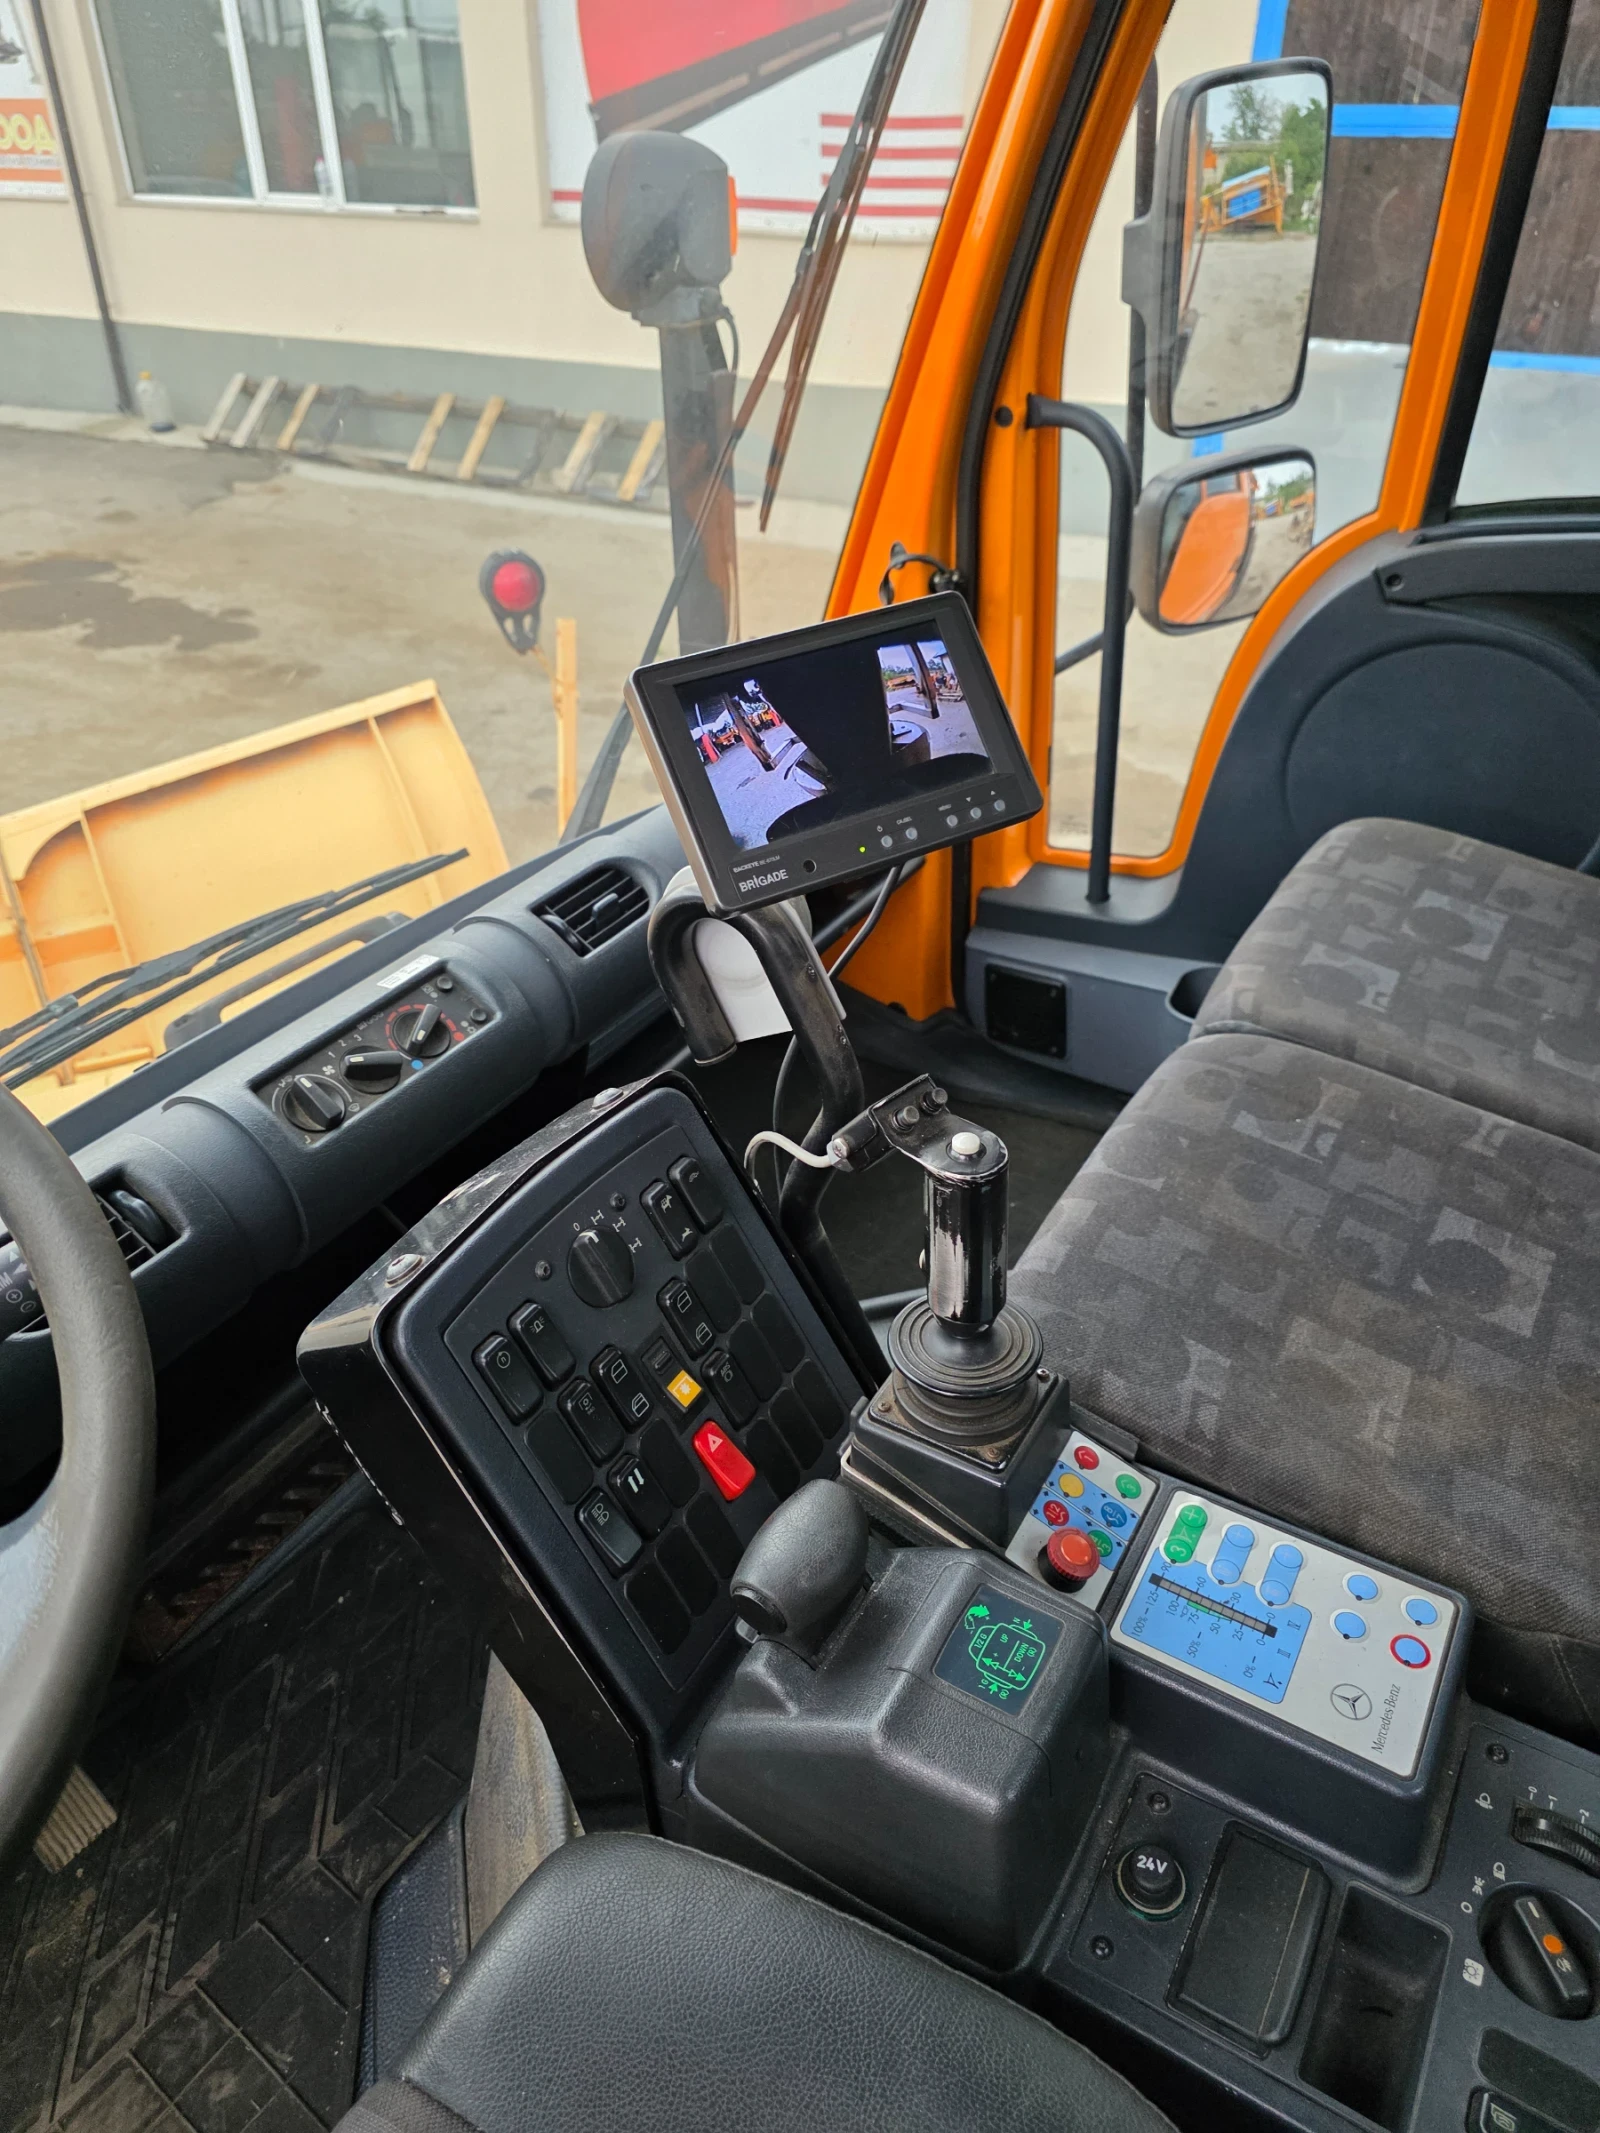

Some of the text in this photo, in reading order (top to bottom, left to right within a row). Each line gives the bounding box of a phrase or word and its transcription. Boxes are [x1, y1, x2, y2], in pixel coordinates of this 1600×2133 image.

[738, 869, 789, 893] BRIGADE
[1197, 1576, 1207, 1589] 60
[1145, 1590, 1158, 1607] 125
[1230, 1591, 1242, 1604] 30
[1166, 1599, 1180, 1616] 100
[1131, 1615, 1149, 1637] 100%
[1188, 1613, 1200, 1625] 75
[1209, 1622, 1221, 1635] 50
[1232, 1628, 1245, 1642] 25
[1000, 1633, 1009, 1643] UP
[1014, 1642, 1029, 1662] DOWN
[1186, 1640, 1202, 1658] 50%
[1243, 1664, 1257, 1679] 0%
[1371, 1683, 1401, 1754] Mercedes-Benz
[1136, 1855, 1168, 1874] 24V
